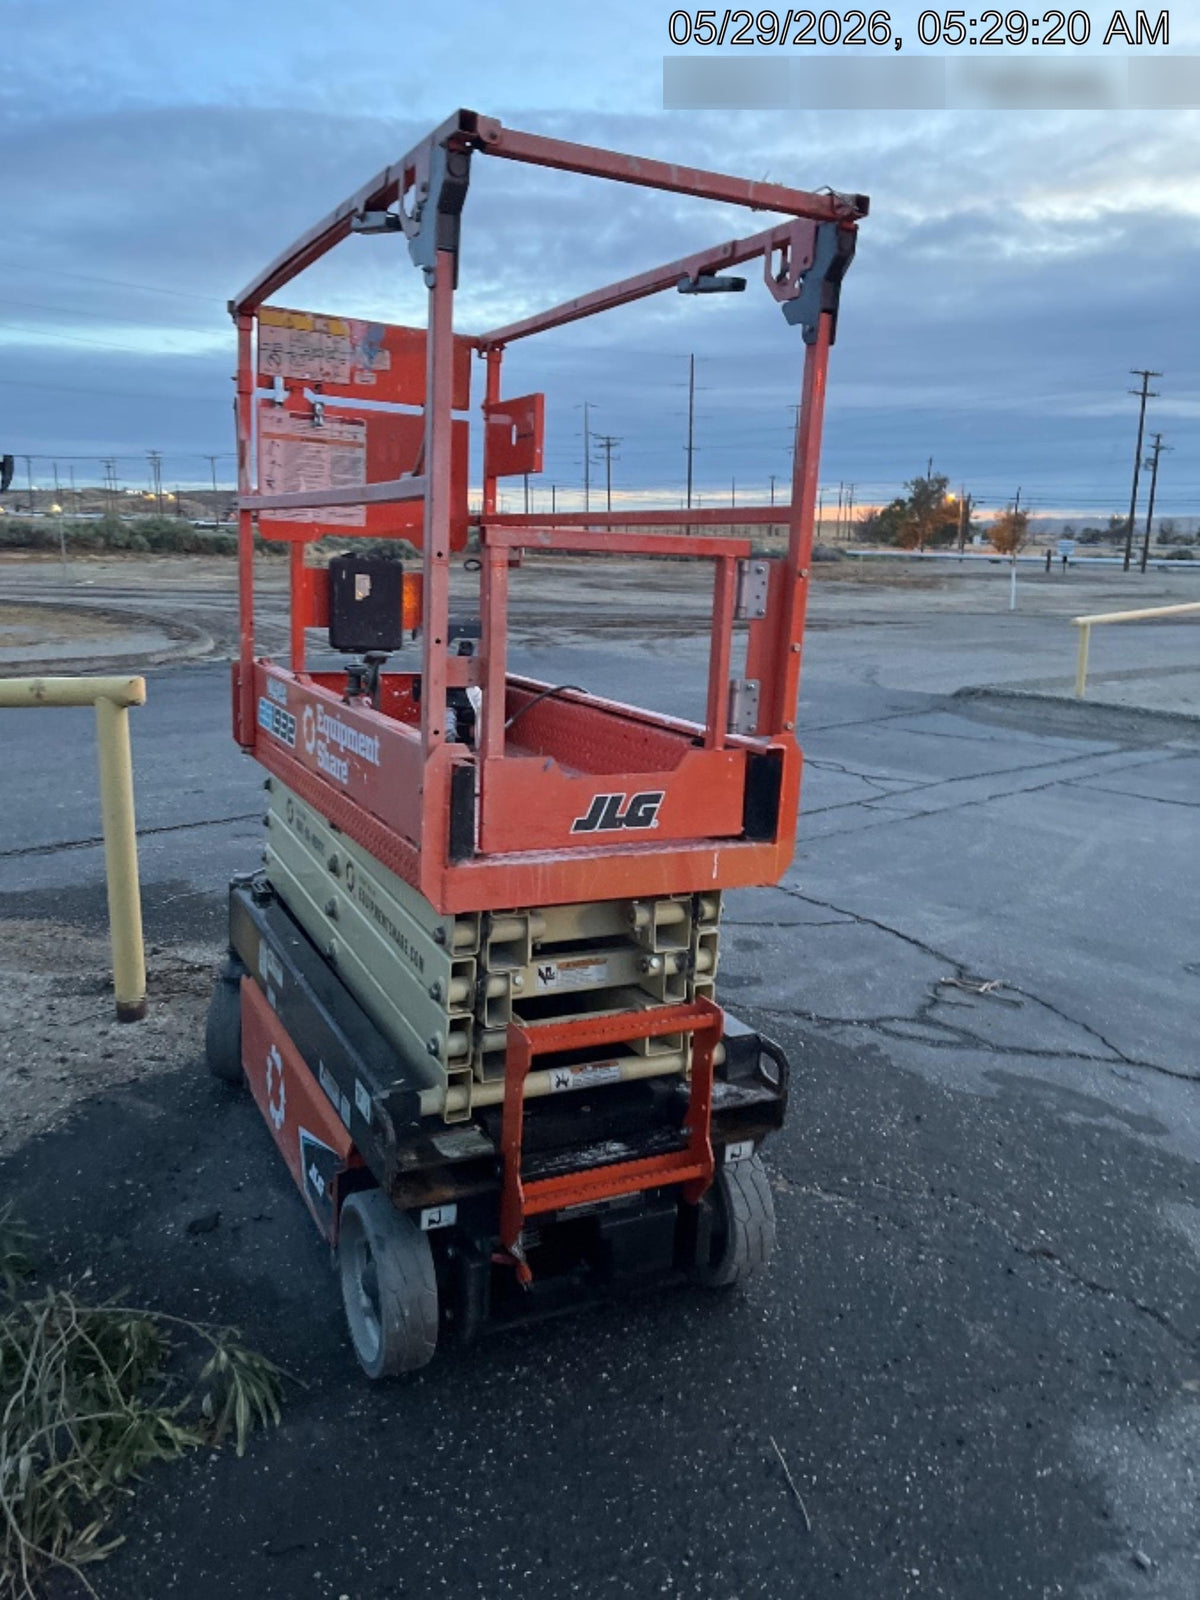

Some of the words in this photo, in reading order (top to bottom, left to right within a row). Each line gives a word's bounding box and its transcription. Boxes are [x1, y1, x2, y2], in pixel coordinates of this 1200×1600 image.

[316, 703, 381, 768] Equipment
[317, 738, 350, 785] Share
[569, 790, 666, 834] JLG
